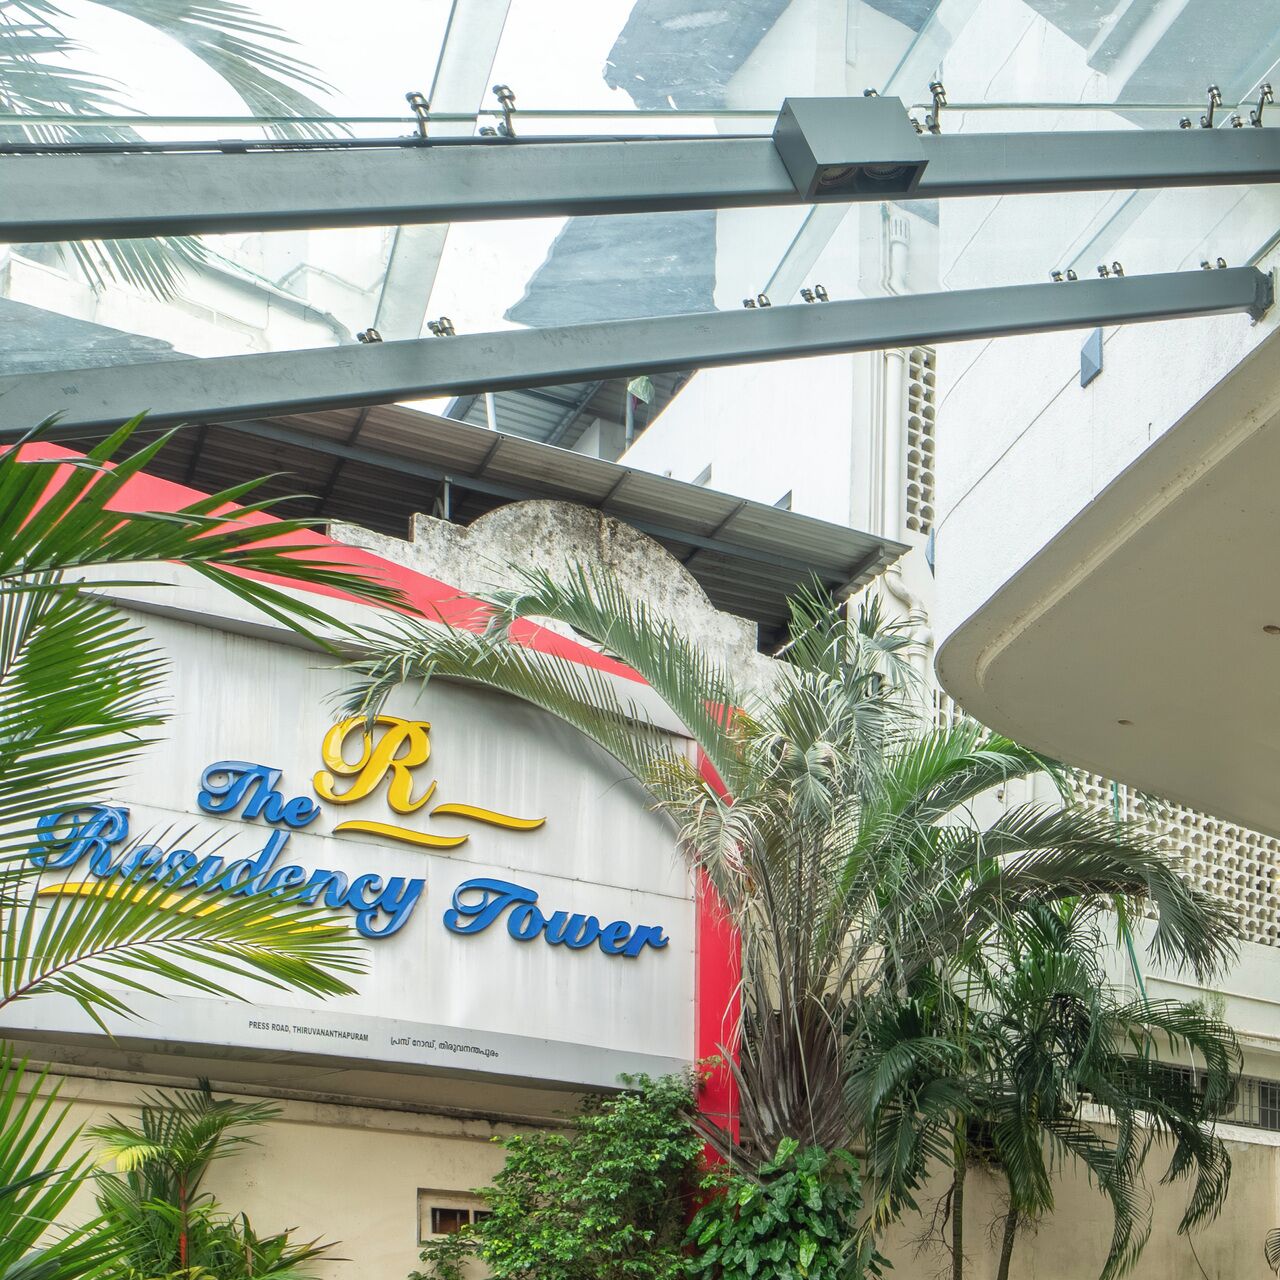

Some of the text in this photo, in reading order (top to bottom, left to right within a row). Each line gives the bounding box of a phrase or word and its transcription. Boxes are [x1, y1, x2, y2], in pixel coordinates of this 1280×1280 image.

[197, 760, 321, 829] The
[312, 714, 438, 815] R
[28, 802, 670, 958] Residency Tower
[248, 1020, 369, 1042] PRESS ROAD, THIRUVANANTHAPURAM
[438, 1041, 500, 1058] തിരുവനന്തപുരം
